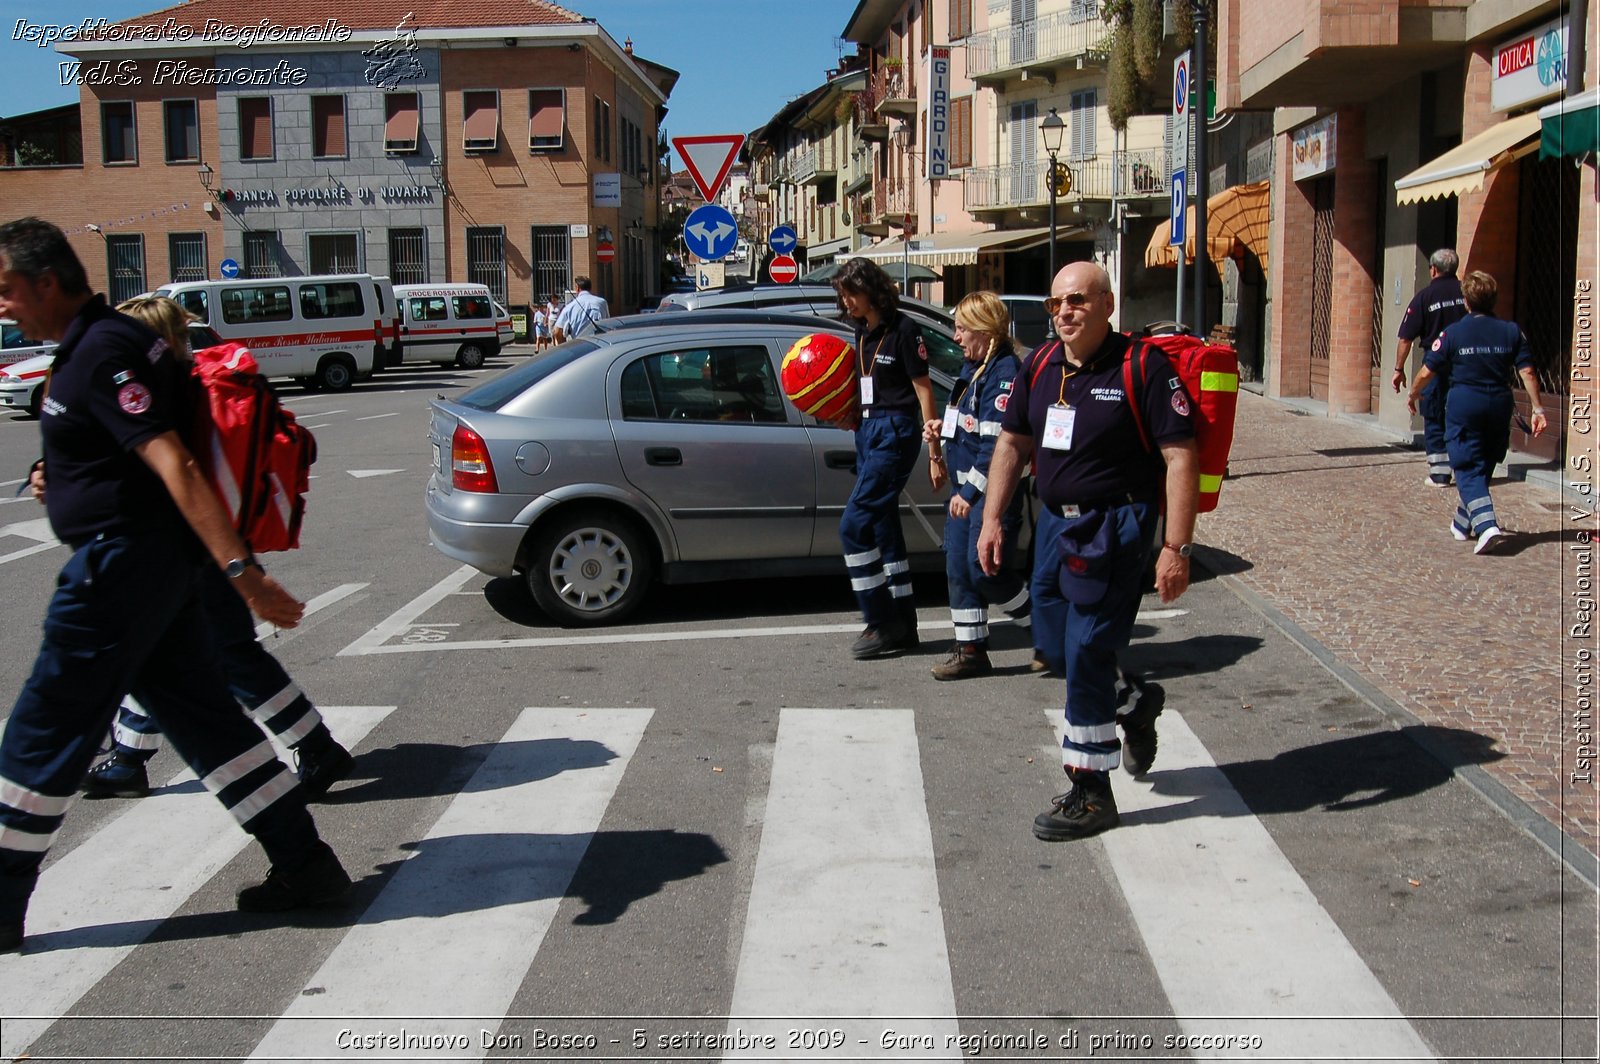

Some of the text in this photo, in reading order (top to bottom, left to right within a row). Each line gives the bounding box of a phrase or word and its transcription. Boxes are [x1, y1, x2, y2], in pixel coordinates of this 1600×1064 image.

[932, 48, 949, 59] BAR
[1500, 42, 1532, 74] OTTICA
[932, 61, 947, 176] GIARDINO
[235, 185, 429, 202] BANCA POPOLARE DI NOVARA
[1172, 179, 1183, 238] P
[247, 332, 341, 348] Croce Rossa Italiana
